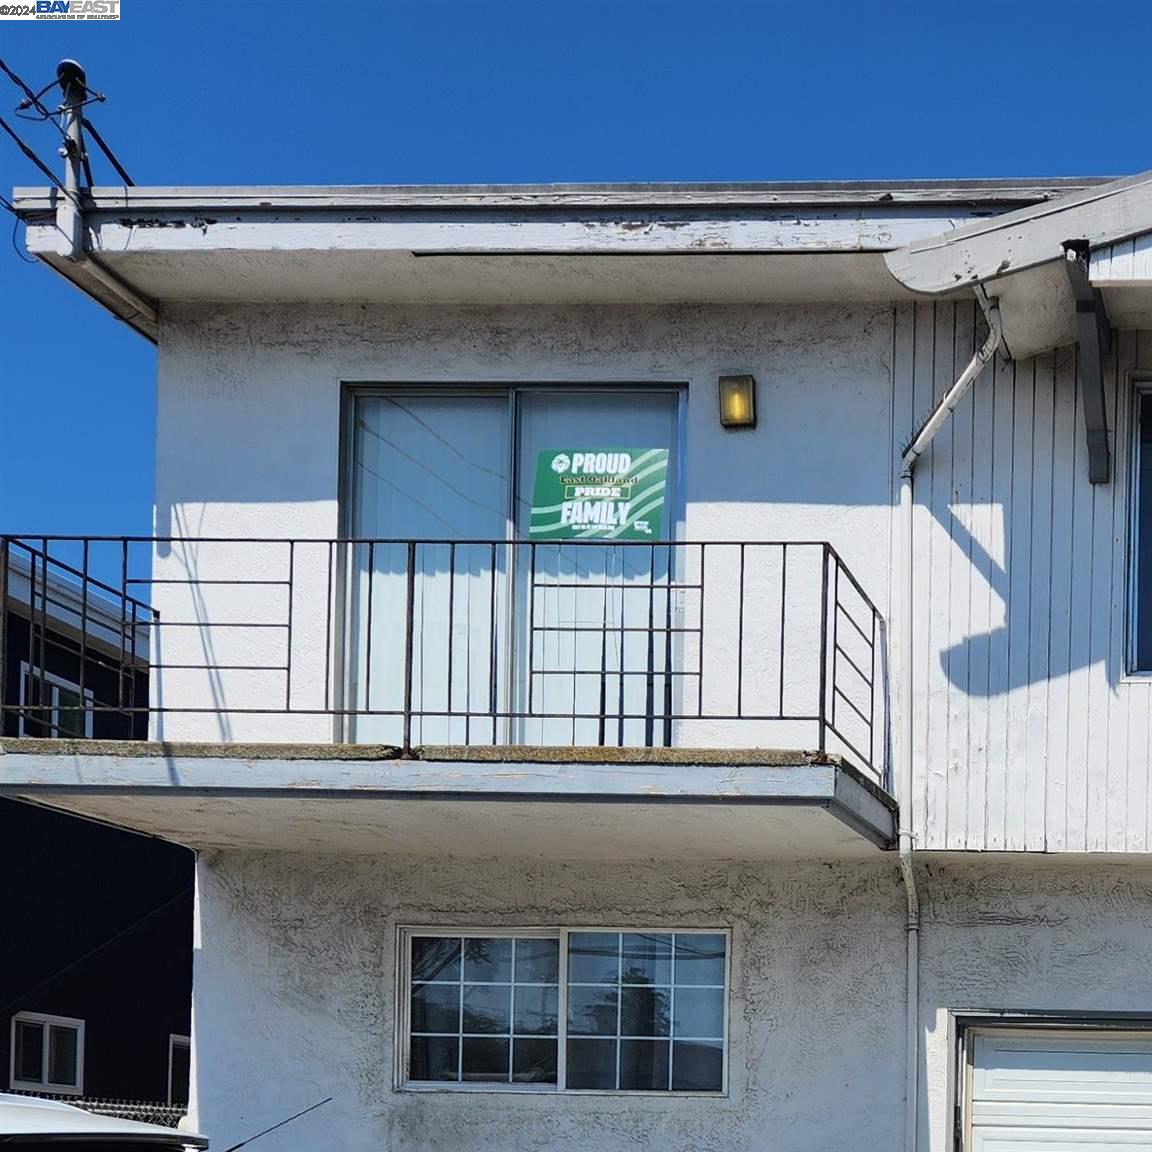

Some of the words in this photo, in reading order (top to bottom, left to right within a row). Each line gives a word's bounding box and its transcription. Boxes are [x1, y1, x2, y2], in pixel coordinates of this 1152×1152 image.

[571, 453, 631, 474] PROUD
[560, 476, 586, 485] East
[588, 476, 639, 485] Oakland
[574, 487, 621, 497] PRIDE
[561, 502, 631, 525] FAMILY
